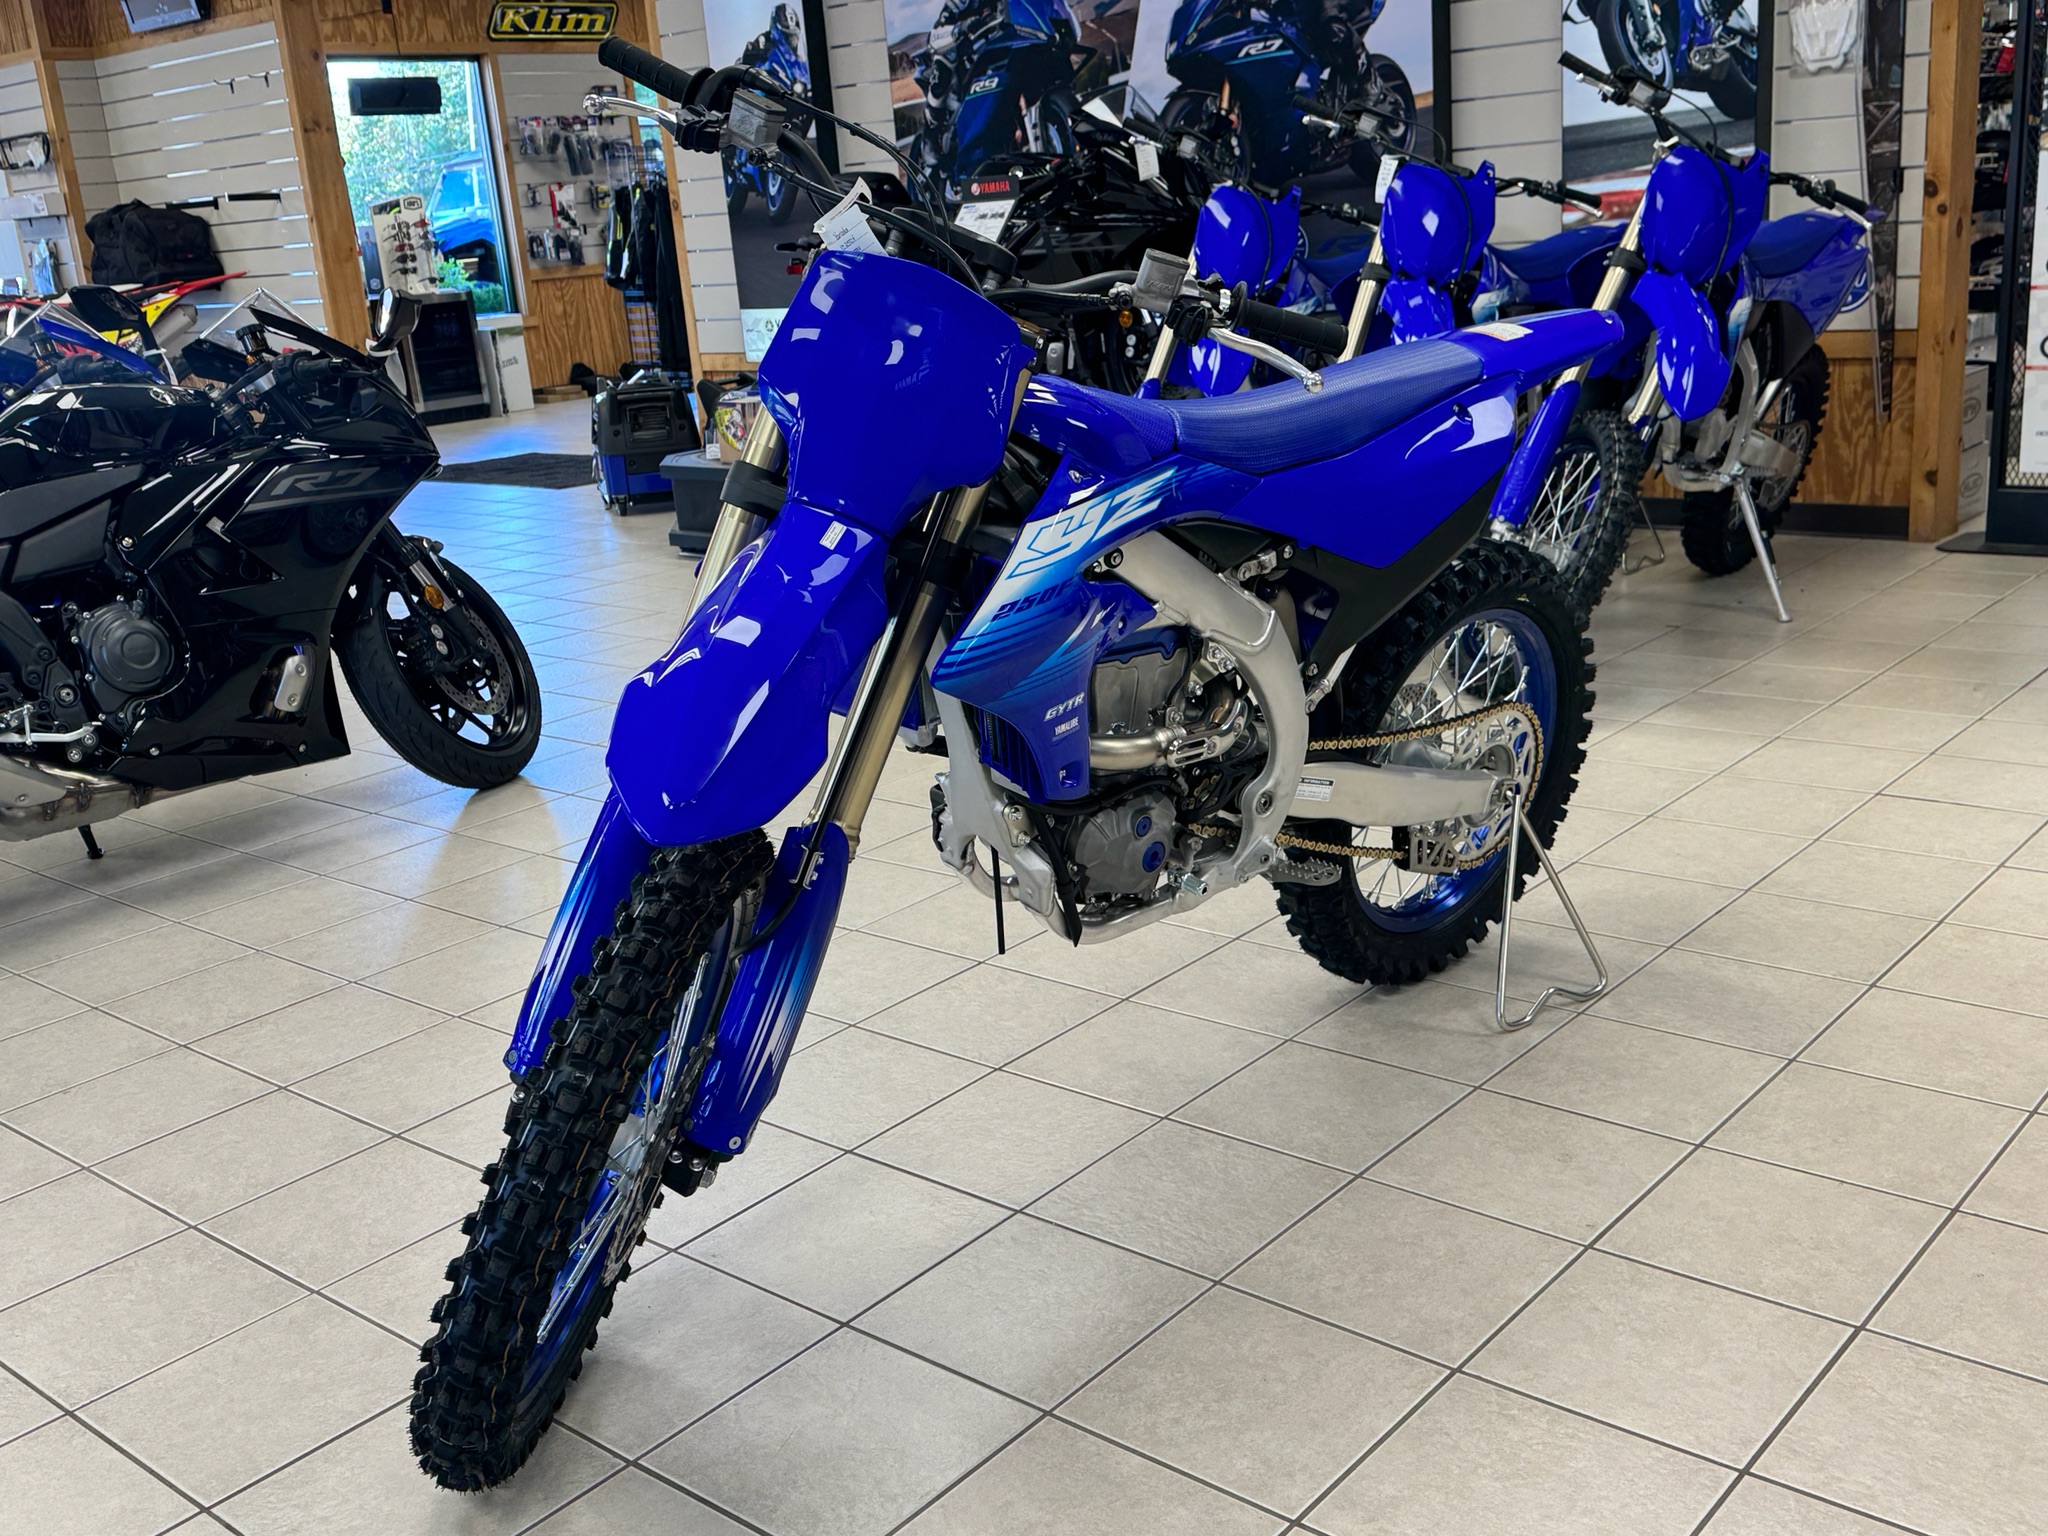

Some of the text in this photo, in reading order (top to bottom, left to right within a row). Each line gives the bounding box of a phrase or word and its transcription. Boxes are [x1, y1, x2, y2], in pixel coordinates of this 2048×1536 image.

[499, 7, 605, 33] Klim
[1237, 38, 1283, 58] R7
[970, 77, 999, 94] R9
[980, 180, 1011, 194] YAMAHA
[270, 466, 381, 496] R7
[1004, 465, 1179, 581] YZ
[990, 576, 1078, 622] 250F
[1043, 691, 1085, 722] GYTR
